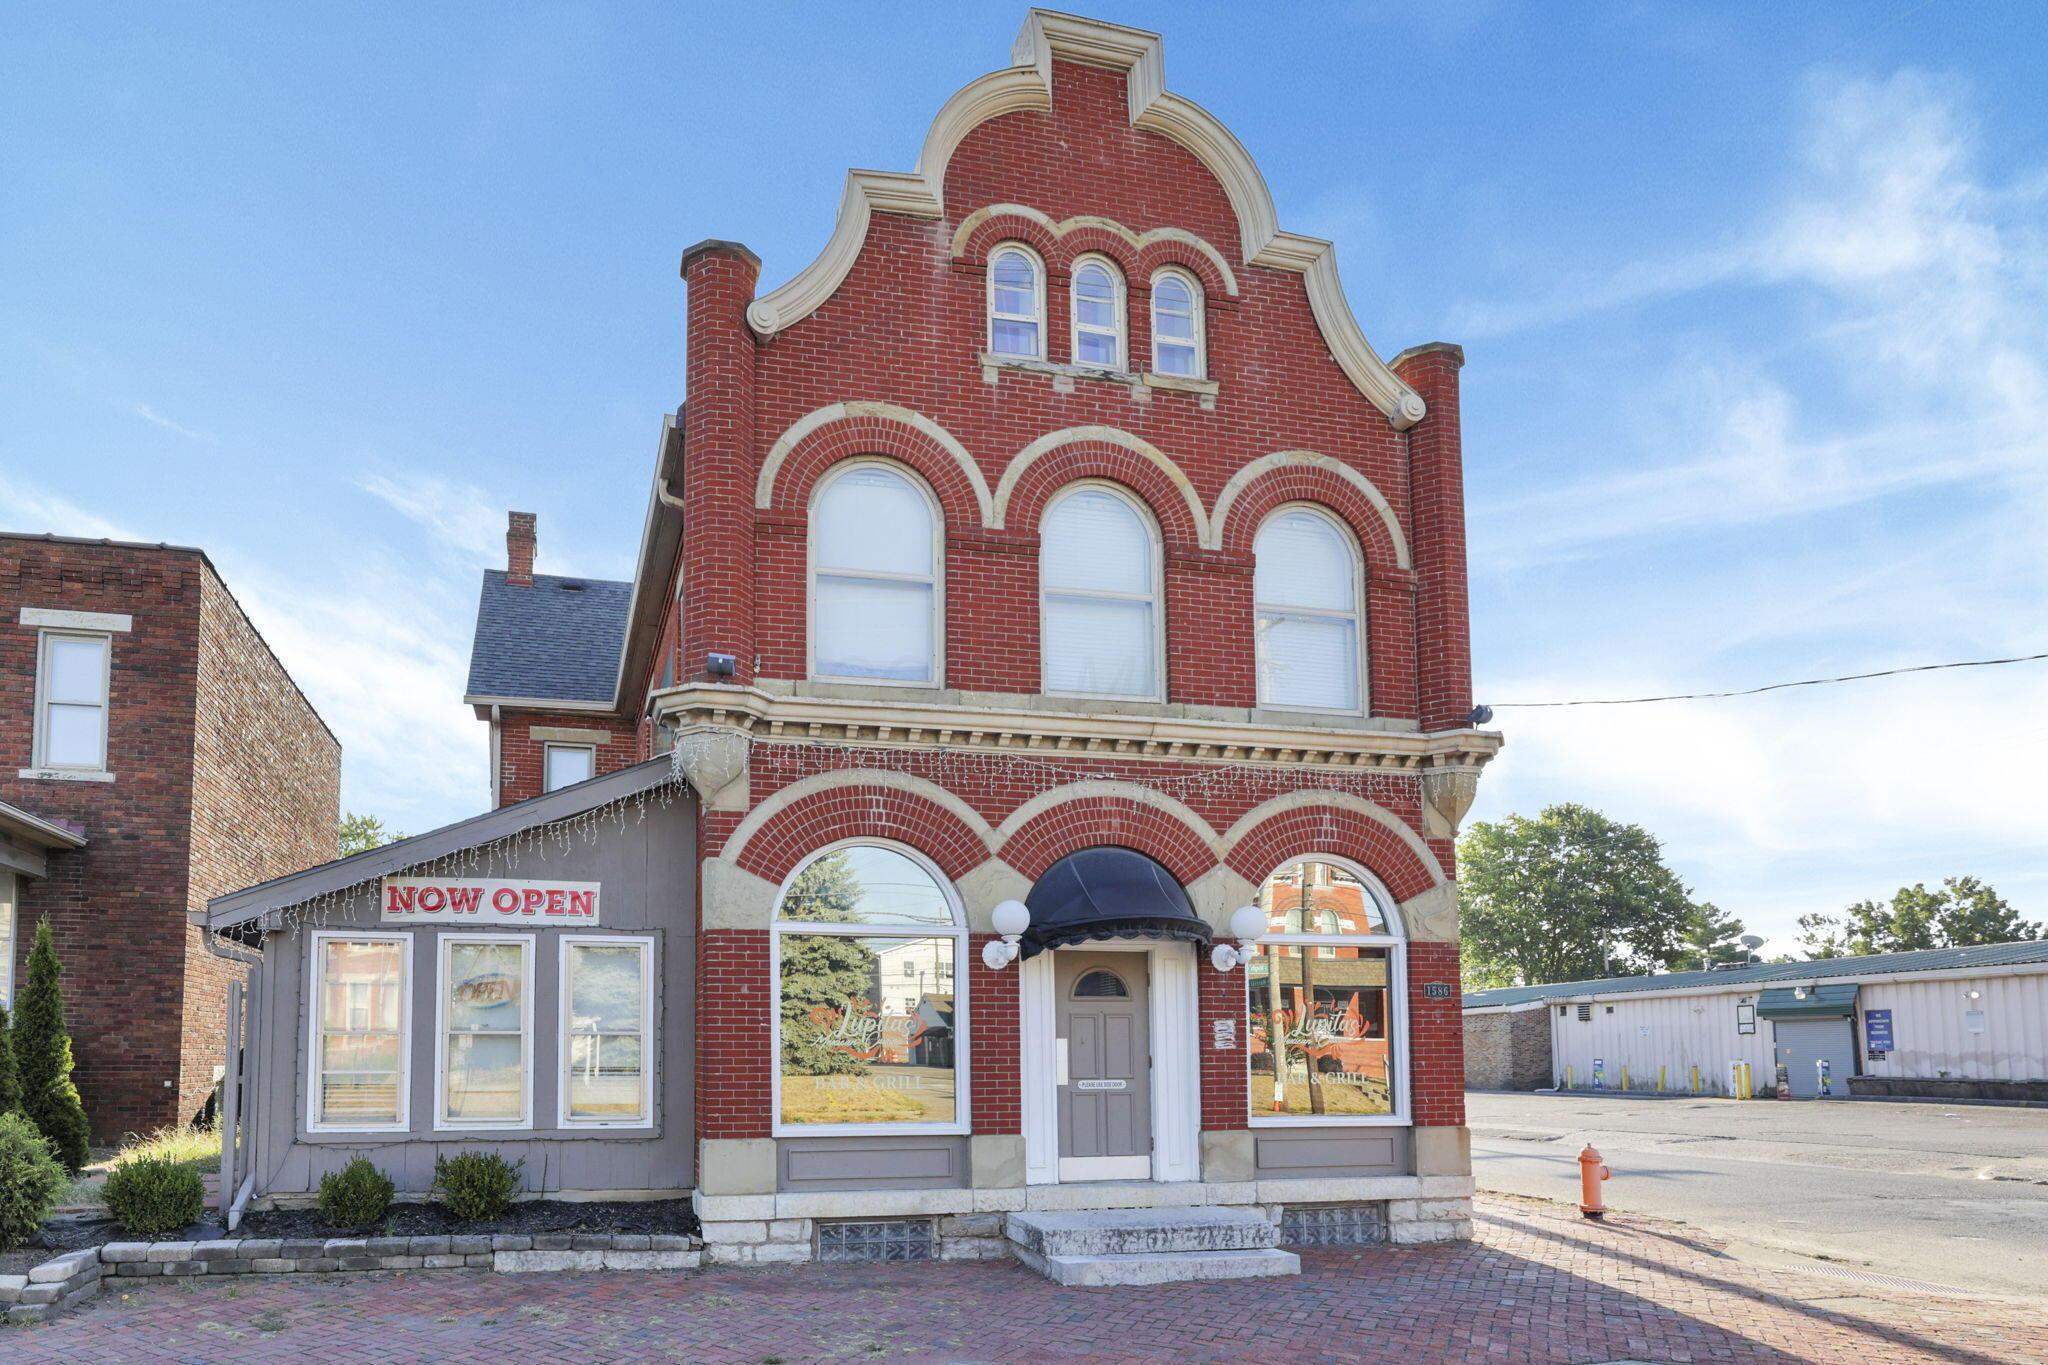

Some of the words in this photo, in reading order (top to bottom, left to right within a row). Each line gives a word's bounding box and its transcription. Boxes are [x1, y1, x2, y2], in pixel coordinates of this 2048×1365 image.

[386, 885, 485, 914] NOW
[492, 887, 597, 917] OPEN
[1427, 986, 1449, 996] 1586
[873, 1076, 924, 1090] GRILL
[1310, 1071, 1321, 1085] &
[1325, 1071, 1370, 1086] GRILL
